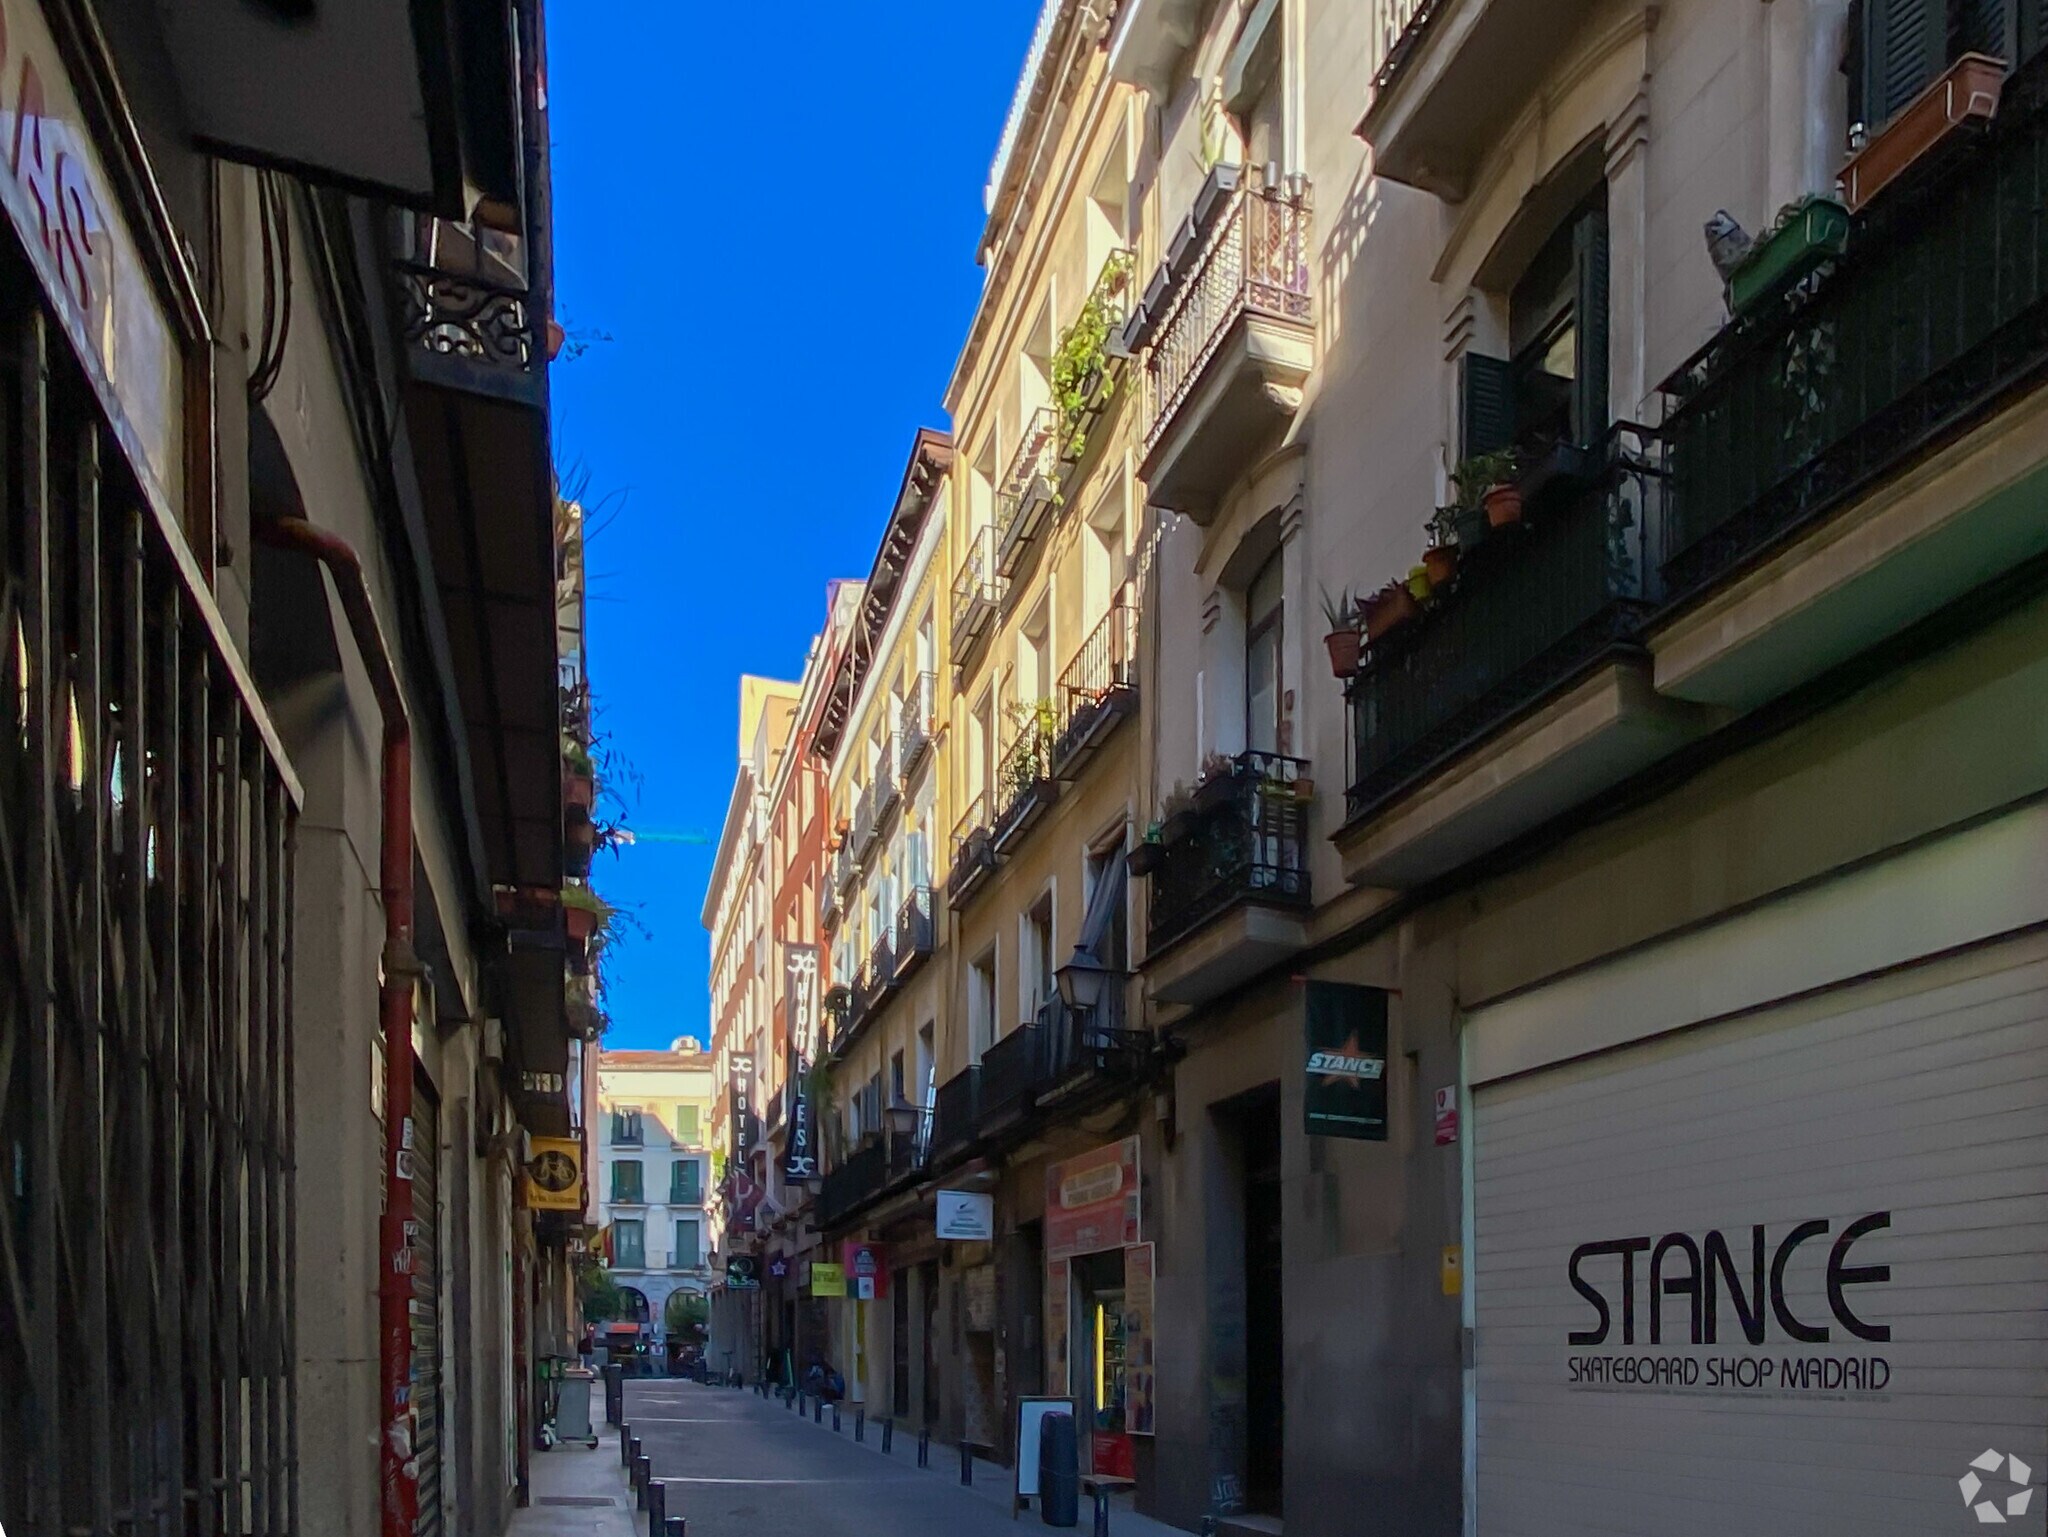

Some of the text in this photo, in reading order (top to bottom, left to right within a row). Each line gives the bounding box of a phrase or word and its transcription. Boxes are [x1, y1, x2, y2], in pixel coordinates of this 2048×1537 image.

[1307, 1052, 1385, 1073] STANCE
[737, 1078, 747, 1165] HOTEL
[1568, 1211, 1891, 1346] STANCE
[1568, 1356, 1891, 1390] SKATEBOARD SHOP MADRID
